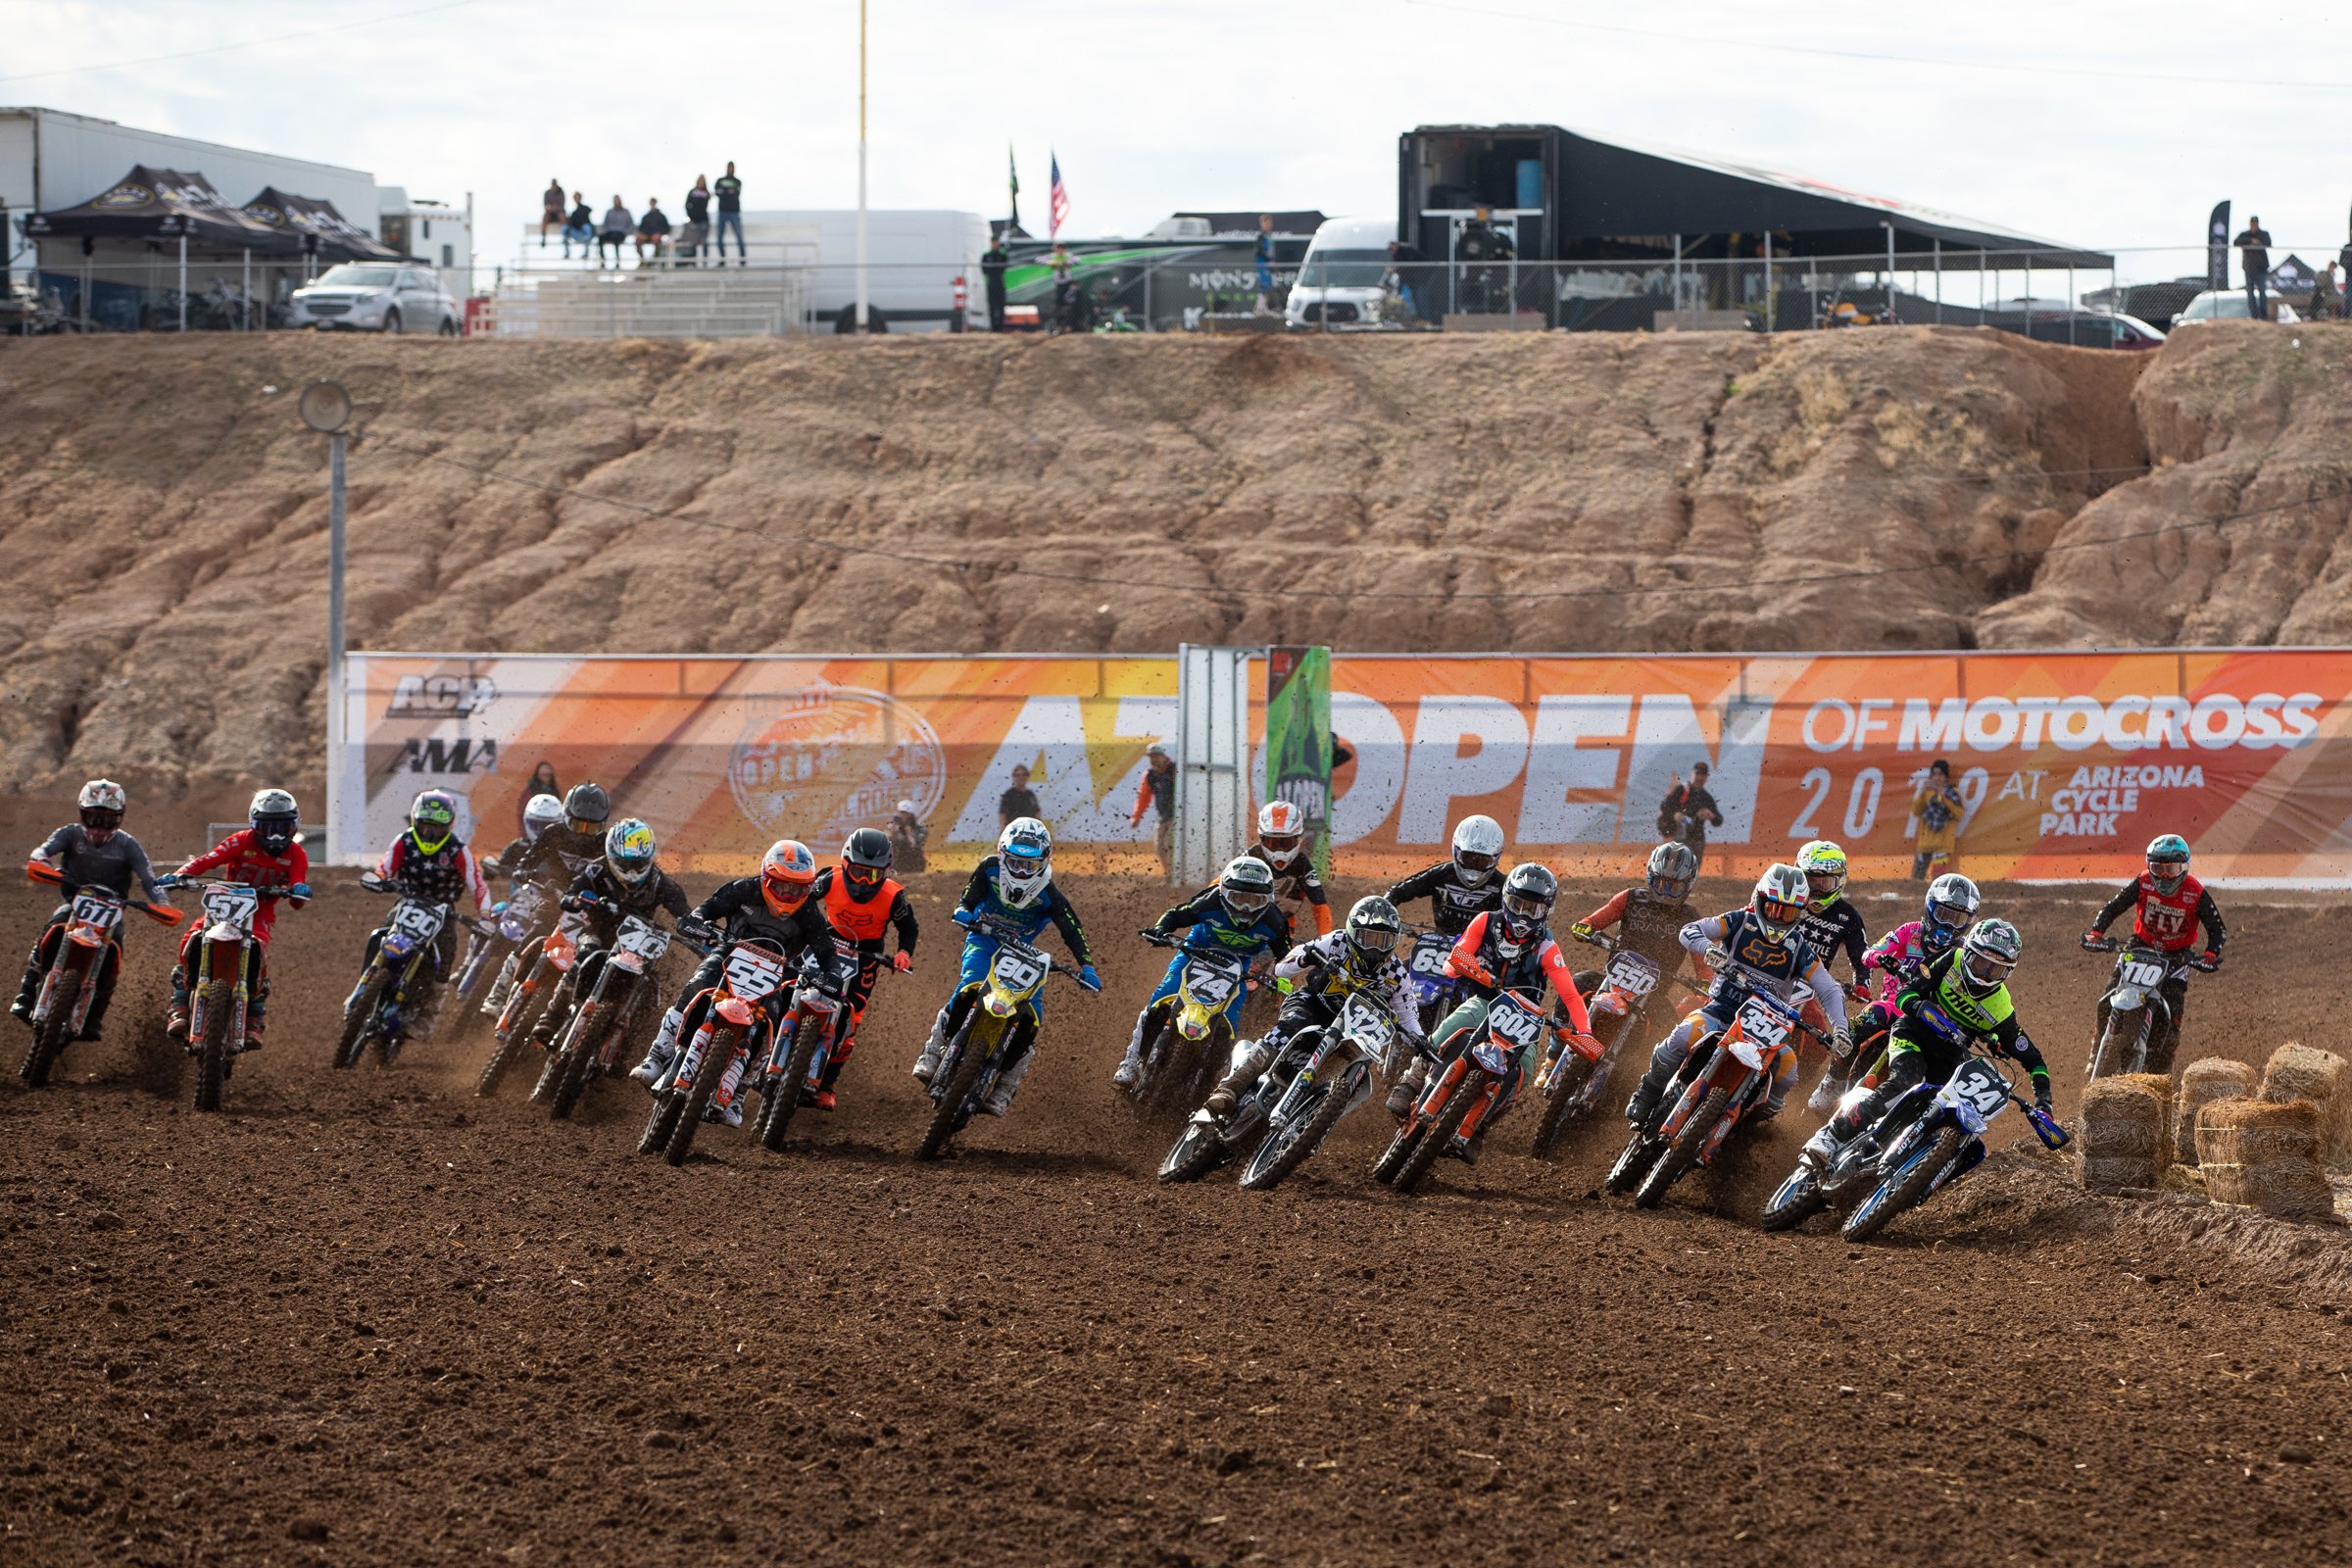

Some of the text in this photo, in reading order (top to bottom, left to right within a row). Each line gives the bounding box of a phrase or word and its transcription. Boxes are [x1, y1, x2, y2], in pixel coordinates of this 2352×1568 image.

[1801, 692, 2325, 754] OF MOTOCROSS
[386, 738, 499, 773] AMA
[1250, 691, 1773, 845] OPEN
[1997, 769, 2049, 801] AT
[2068, 764, 2205, 789] ARIZONA
[2050, 788, 2140, 813] CYCLE
[2038, 812, 2121, 837] PARK
[77, 899, 119, 927] 671
[208, 894, 256, 920] 57
[395, 905, 442, 937] 130
[1629, 918, 1678, 936] BRAND
[739, 942, 784, 964] RENTHAL
[726, 959, 781, 998] 55
[993, 956, 1041, 988] 80
[1185, 967, 1234, 1001] 74
[1607, 961, 1657, 997] 550
[2123, 961, 2163, 987] 110
[1726, 987, 1745, 1003] MX
[1944, 987, 1984, 1025] THOR
[1350, 1004, 1392, 1044] 325
[1489, 1003, 1539, 1048] 604
[1740, 1007, 1789, 1048] 354
[1953, 1072, 2006, 1118] 34
[1896, 1120, 1926, 1155] DUNLOP
